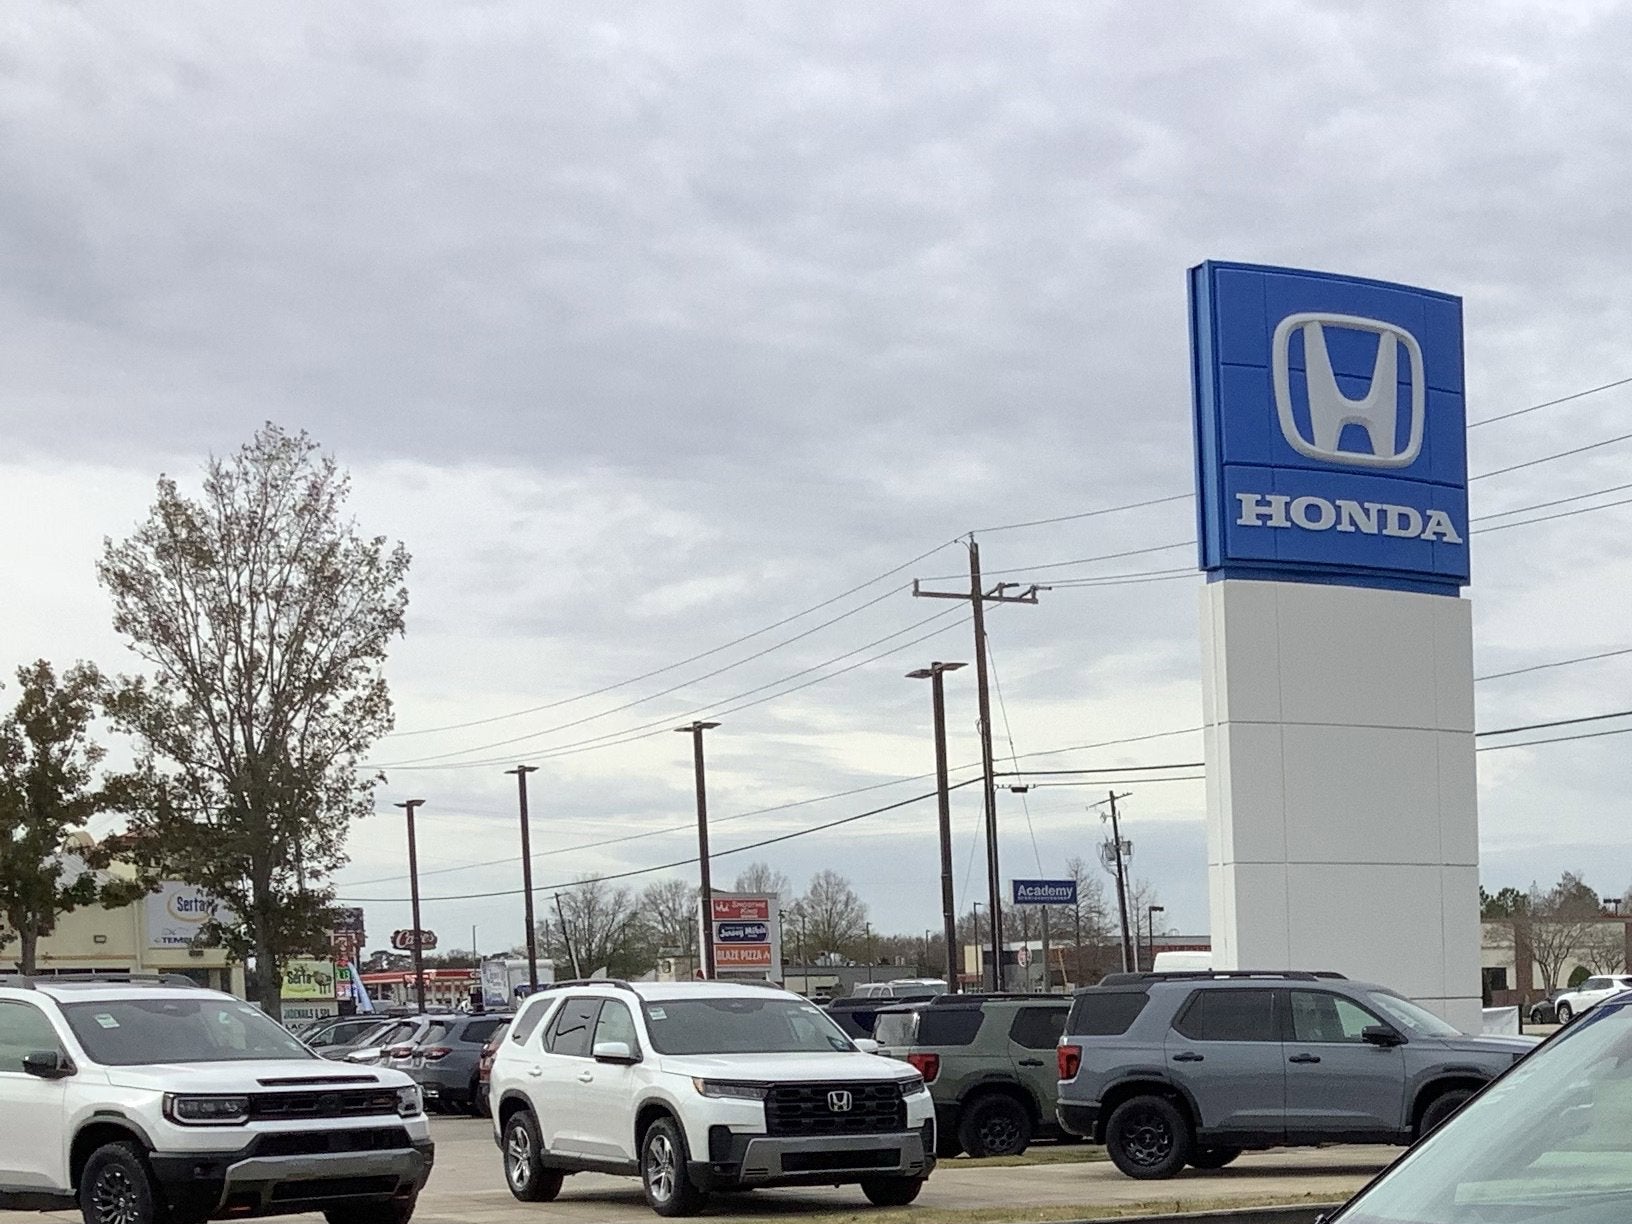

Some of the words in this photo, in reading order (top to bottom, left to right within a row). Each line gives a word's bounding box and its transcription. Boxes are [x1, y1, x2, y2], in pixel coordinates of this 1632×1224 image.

[1236, 492, 1463, 545] HONDA
[1017, 884, 1073, 900] Academy
[176, 896, 208, 912] Serta
[740, 949, 762, 960] PIZZA
